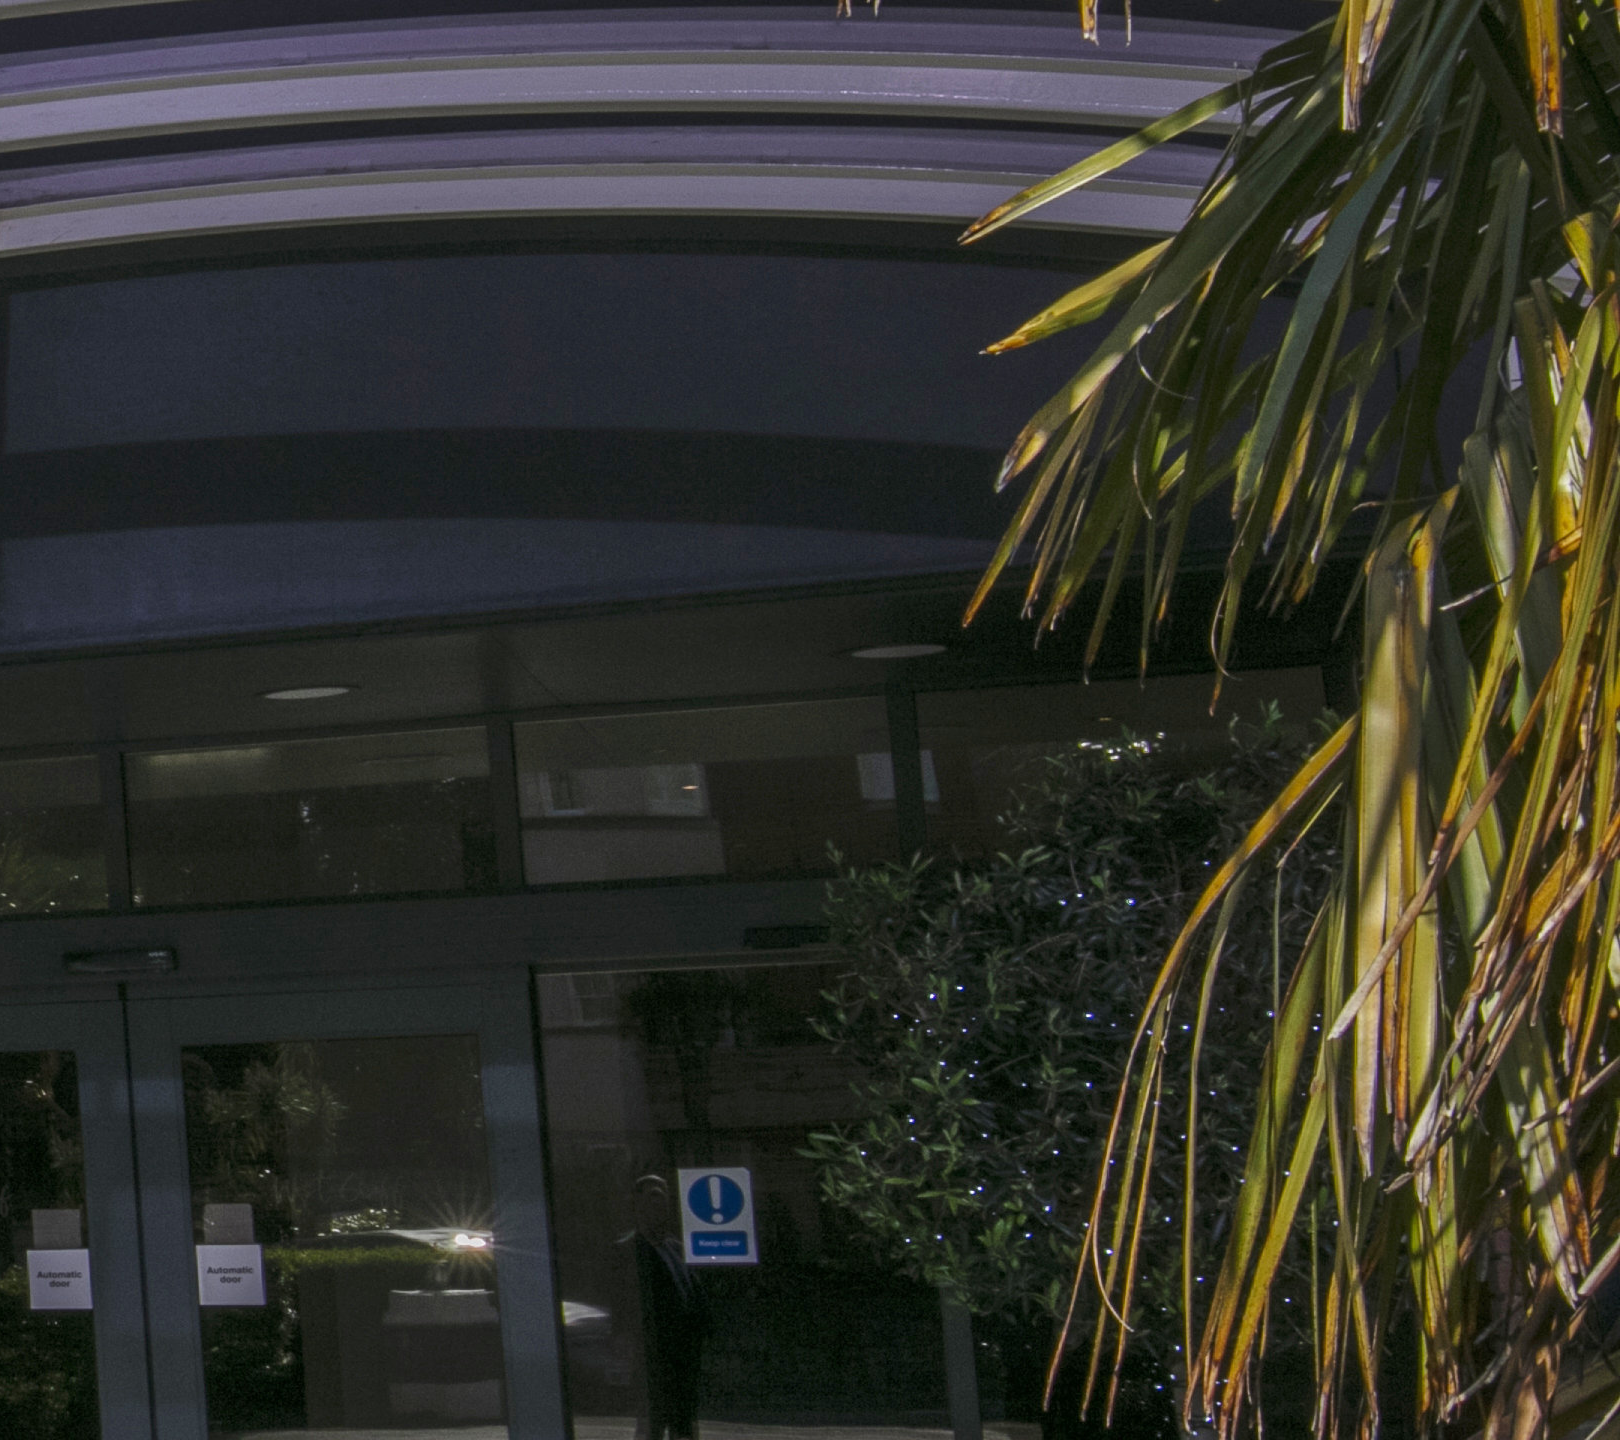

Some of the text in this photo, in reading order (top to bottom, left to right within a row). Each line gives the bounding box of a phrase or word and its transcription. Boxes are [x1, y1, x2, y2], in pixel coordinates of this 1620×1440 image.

[207, 1266, 253, 1274] Automatic
[37, 1270, 82, 1279] Automatic
[220, 1275, 242, 1283] door
[49, 1280, 70, 1288] door
